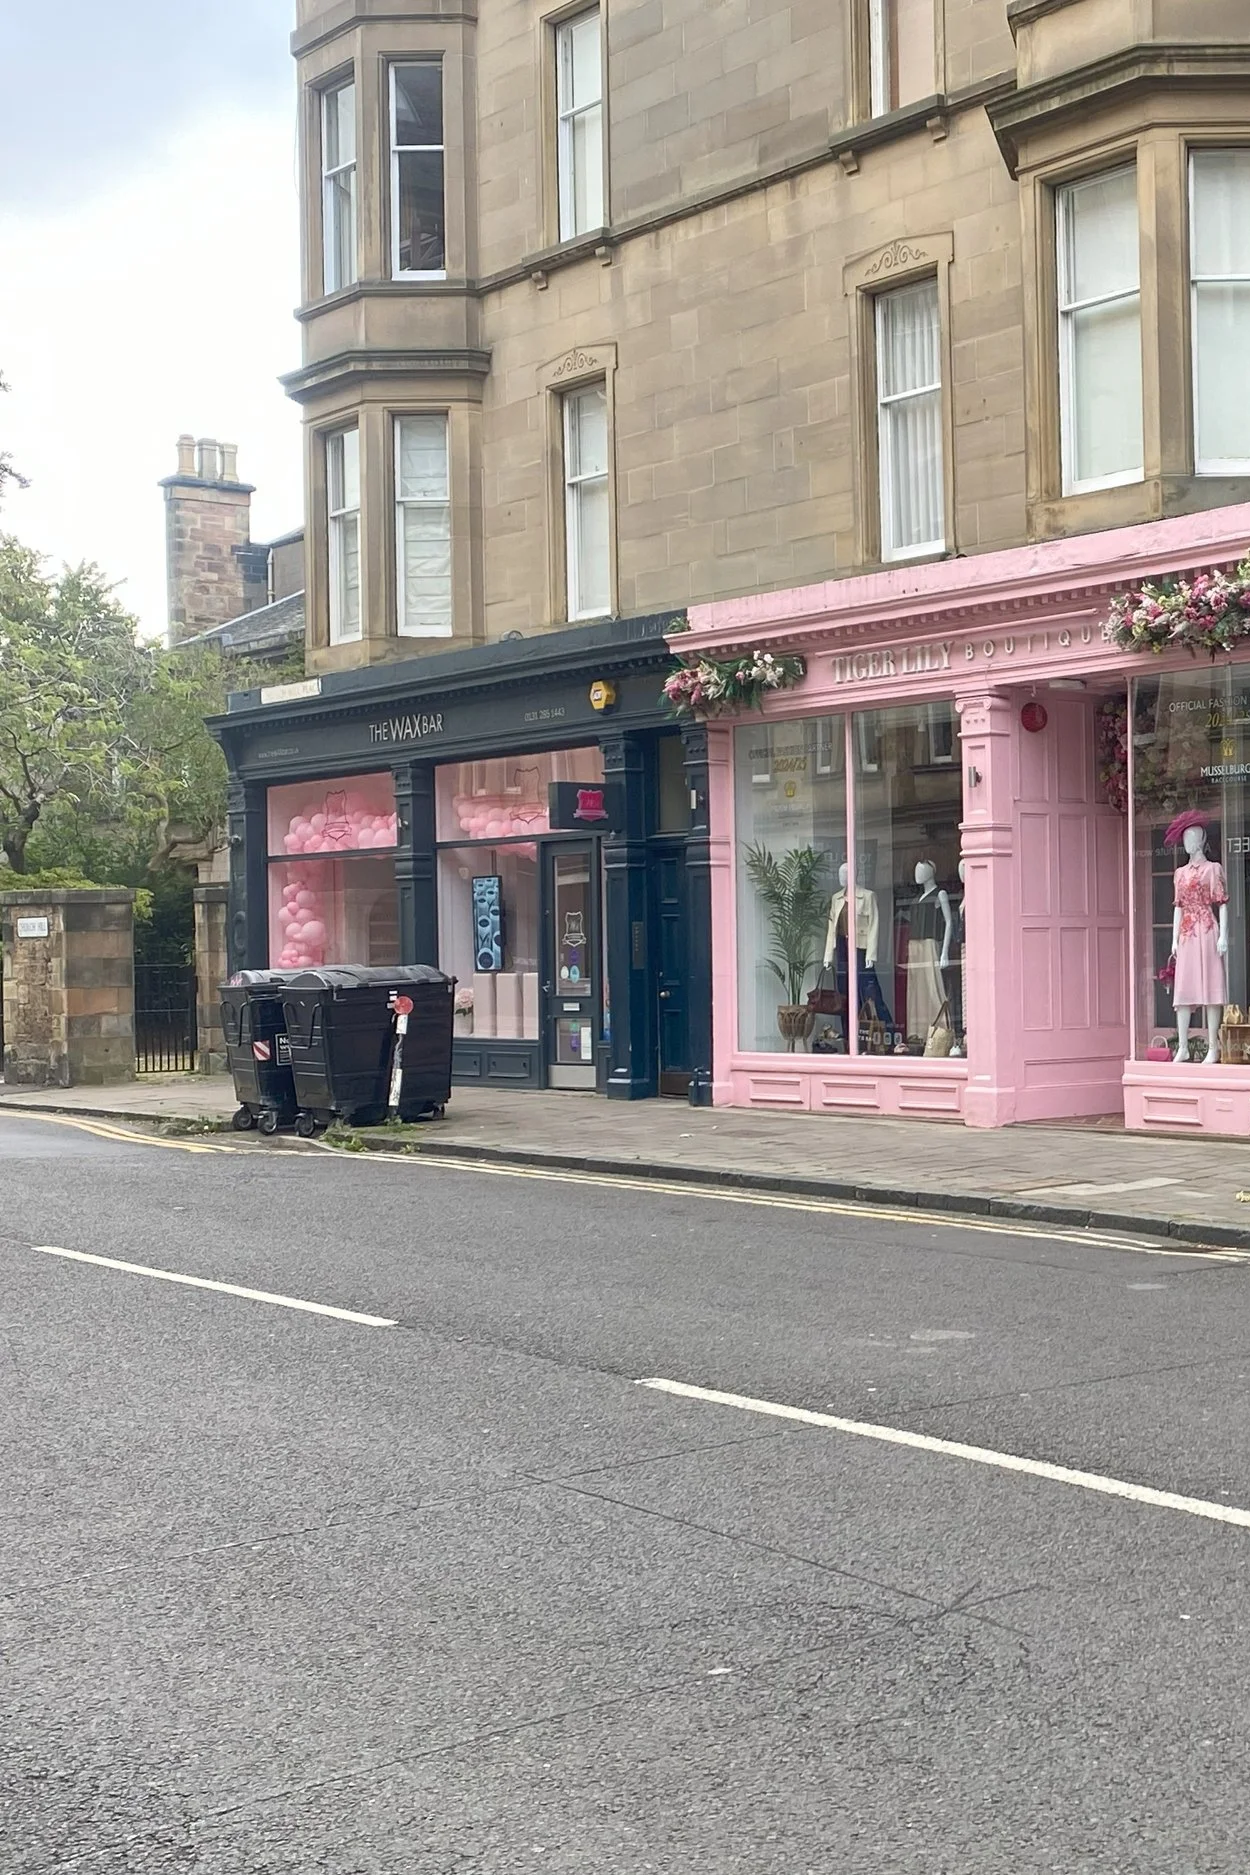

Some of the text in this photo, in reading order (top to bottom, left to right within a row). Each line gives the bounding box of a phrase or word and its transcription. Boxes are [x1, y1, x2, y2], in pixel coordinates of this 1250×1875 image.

[831, 650, 897, 684] TIGER
[901, 640, 955, 675] LILY
[1168, 702, 1206, 713] OFFICIAL
[1208, 695, 1248, 709] FASHION
[369, 722, 388, 743] THE
